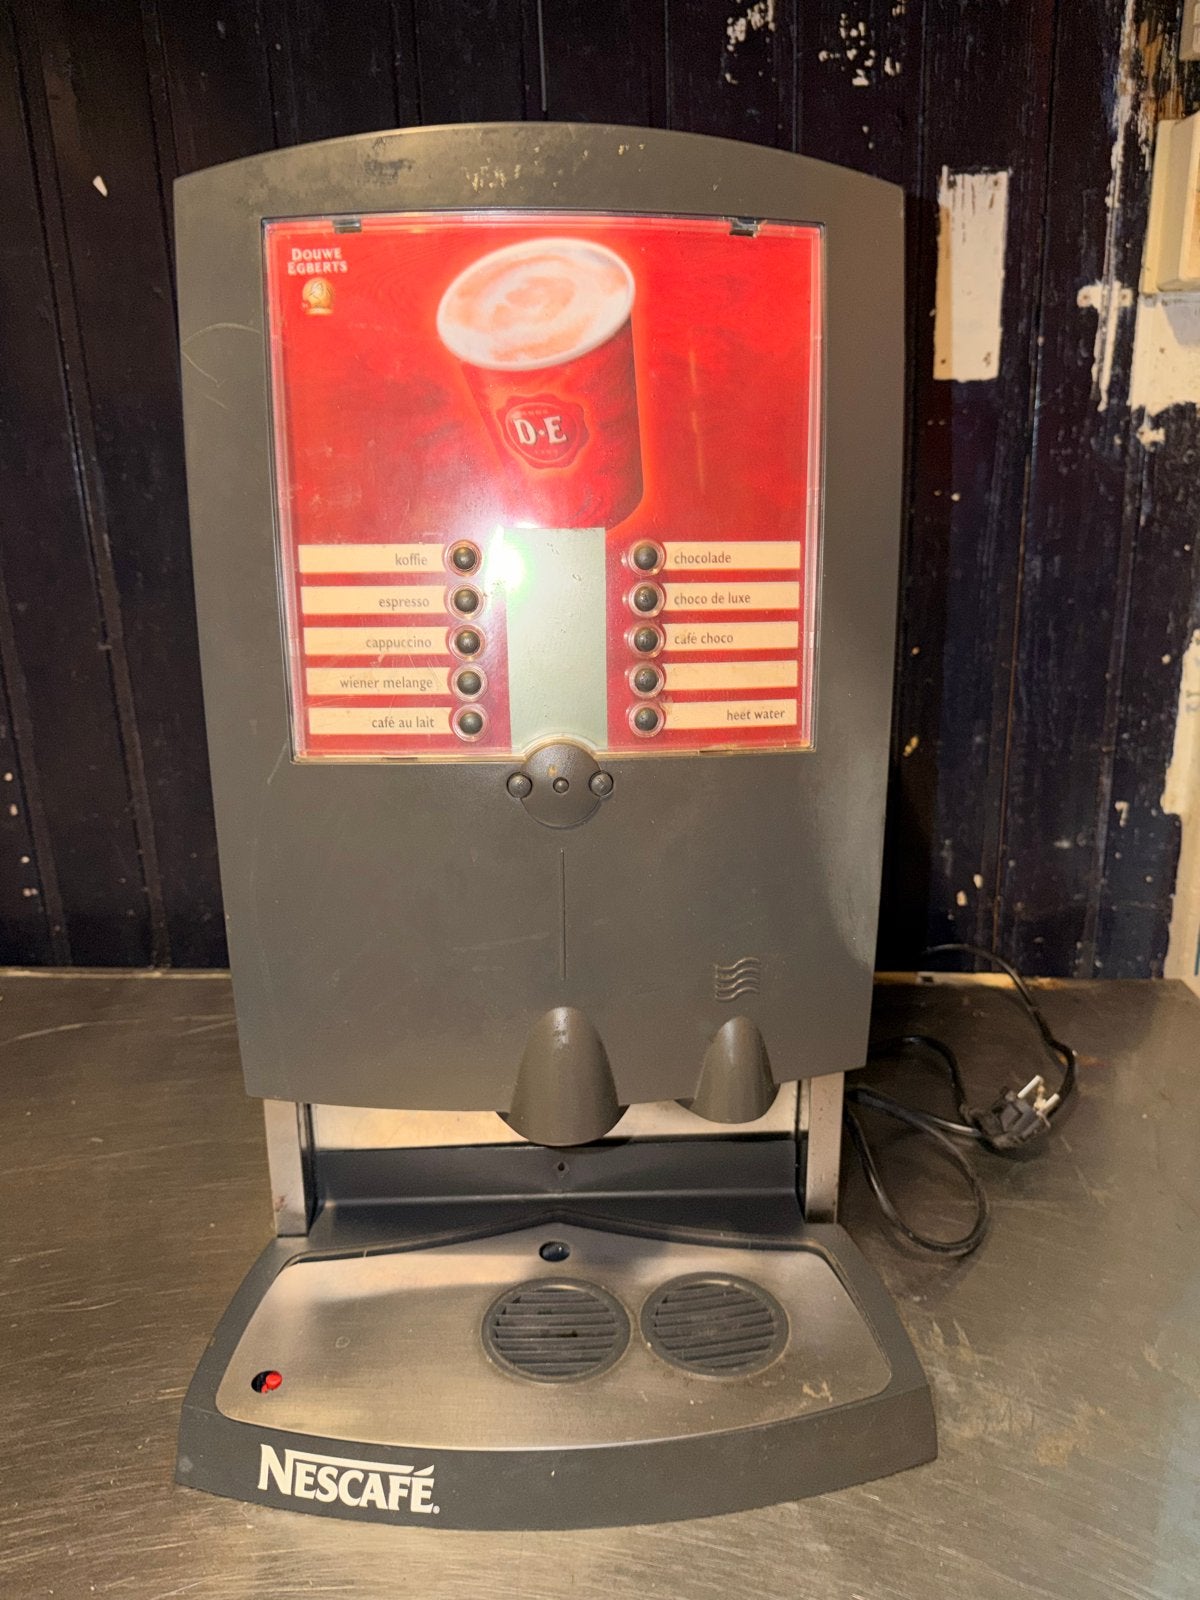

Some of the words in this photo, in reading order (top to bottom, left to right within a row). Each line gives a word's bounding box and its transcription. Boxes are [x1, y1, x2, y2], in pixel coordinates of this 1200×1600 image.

[291, 247, 342, 261] DOUWE
[287, 261, 348, 275] EGBERTS
[395, 552, 428, 566] koffie
[674, 552, 732, 564] chocolade
[378, 596, 429, 610] espresso
[674, 594, 708, 606] choco
[711, 593, 725, 605] de
[728, 592, 751, 604] luxe
[366, 636, 432, 651] cappuccino
[674, 631, 697, 645] café
[700, 632, 734, 644] choco
[340, 677, 380, 688] wiener
[383, 677, 433, 691] melange
[371, 716, 395, 728] café
[398, 719, 412, 728] au
[416, 716, 434, 728] lait
[726, 710, 751, 721] heet
[754, 709, 785, 720] water
